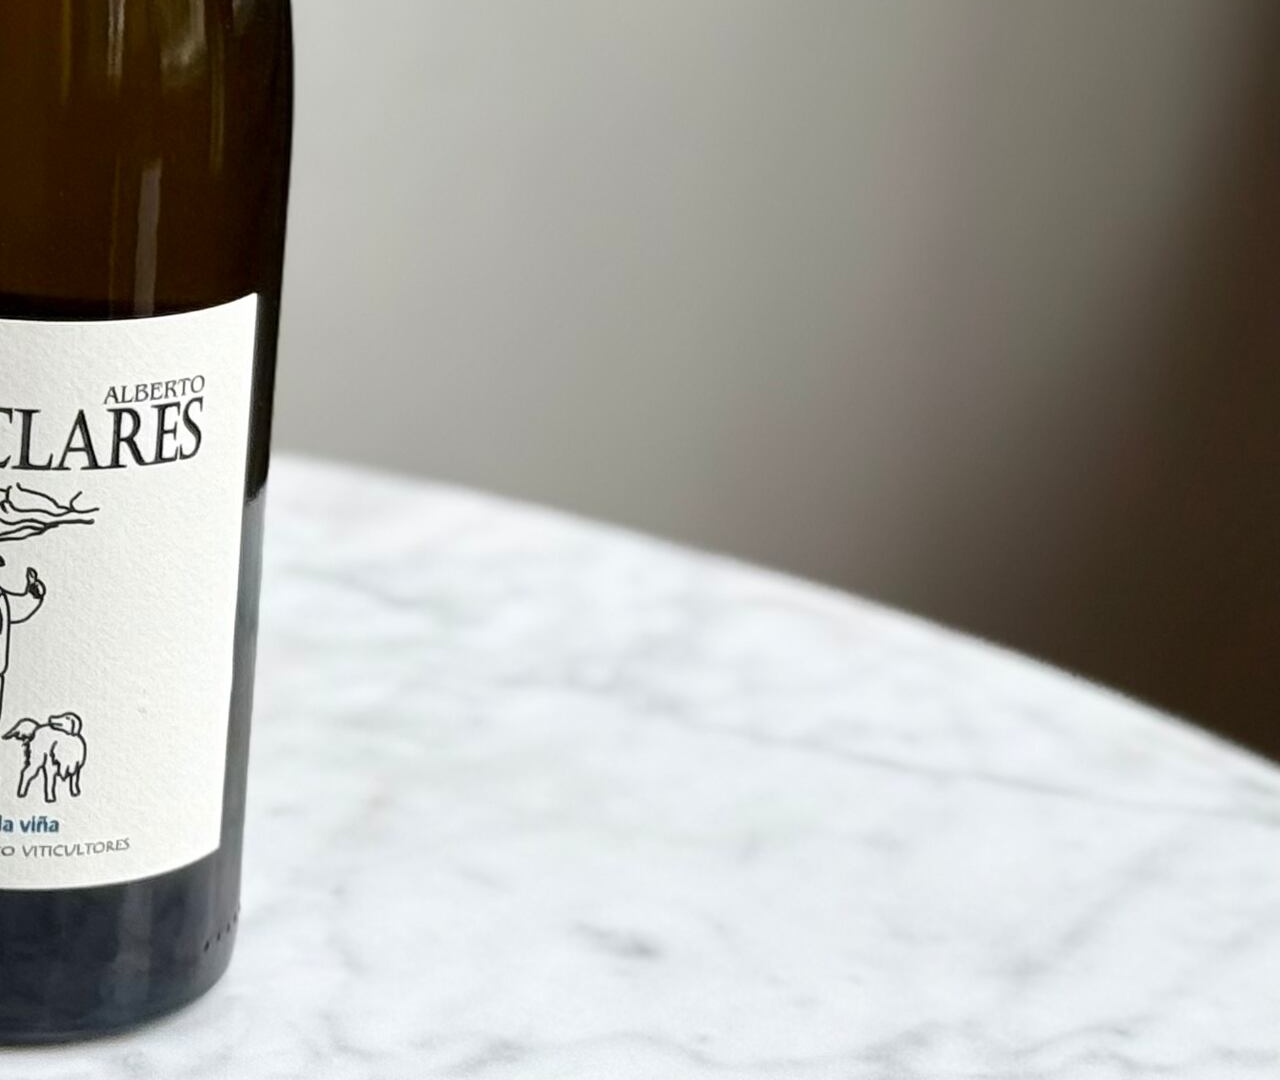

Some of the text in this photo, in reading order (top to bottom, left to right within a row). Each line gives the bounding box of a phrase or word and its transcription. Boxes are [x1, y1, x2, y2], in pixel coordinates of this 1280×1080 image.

[103, 375, 206, 405] ALBERTO
[19, 816, 60, 833] viña
[22, 837, 131, 858] VITICULTORES
